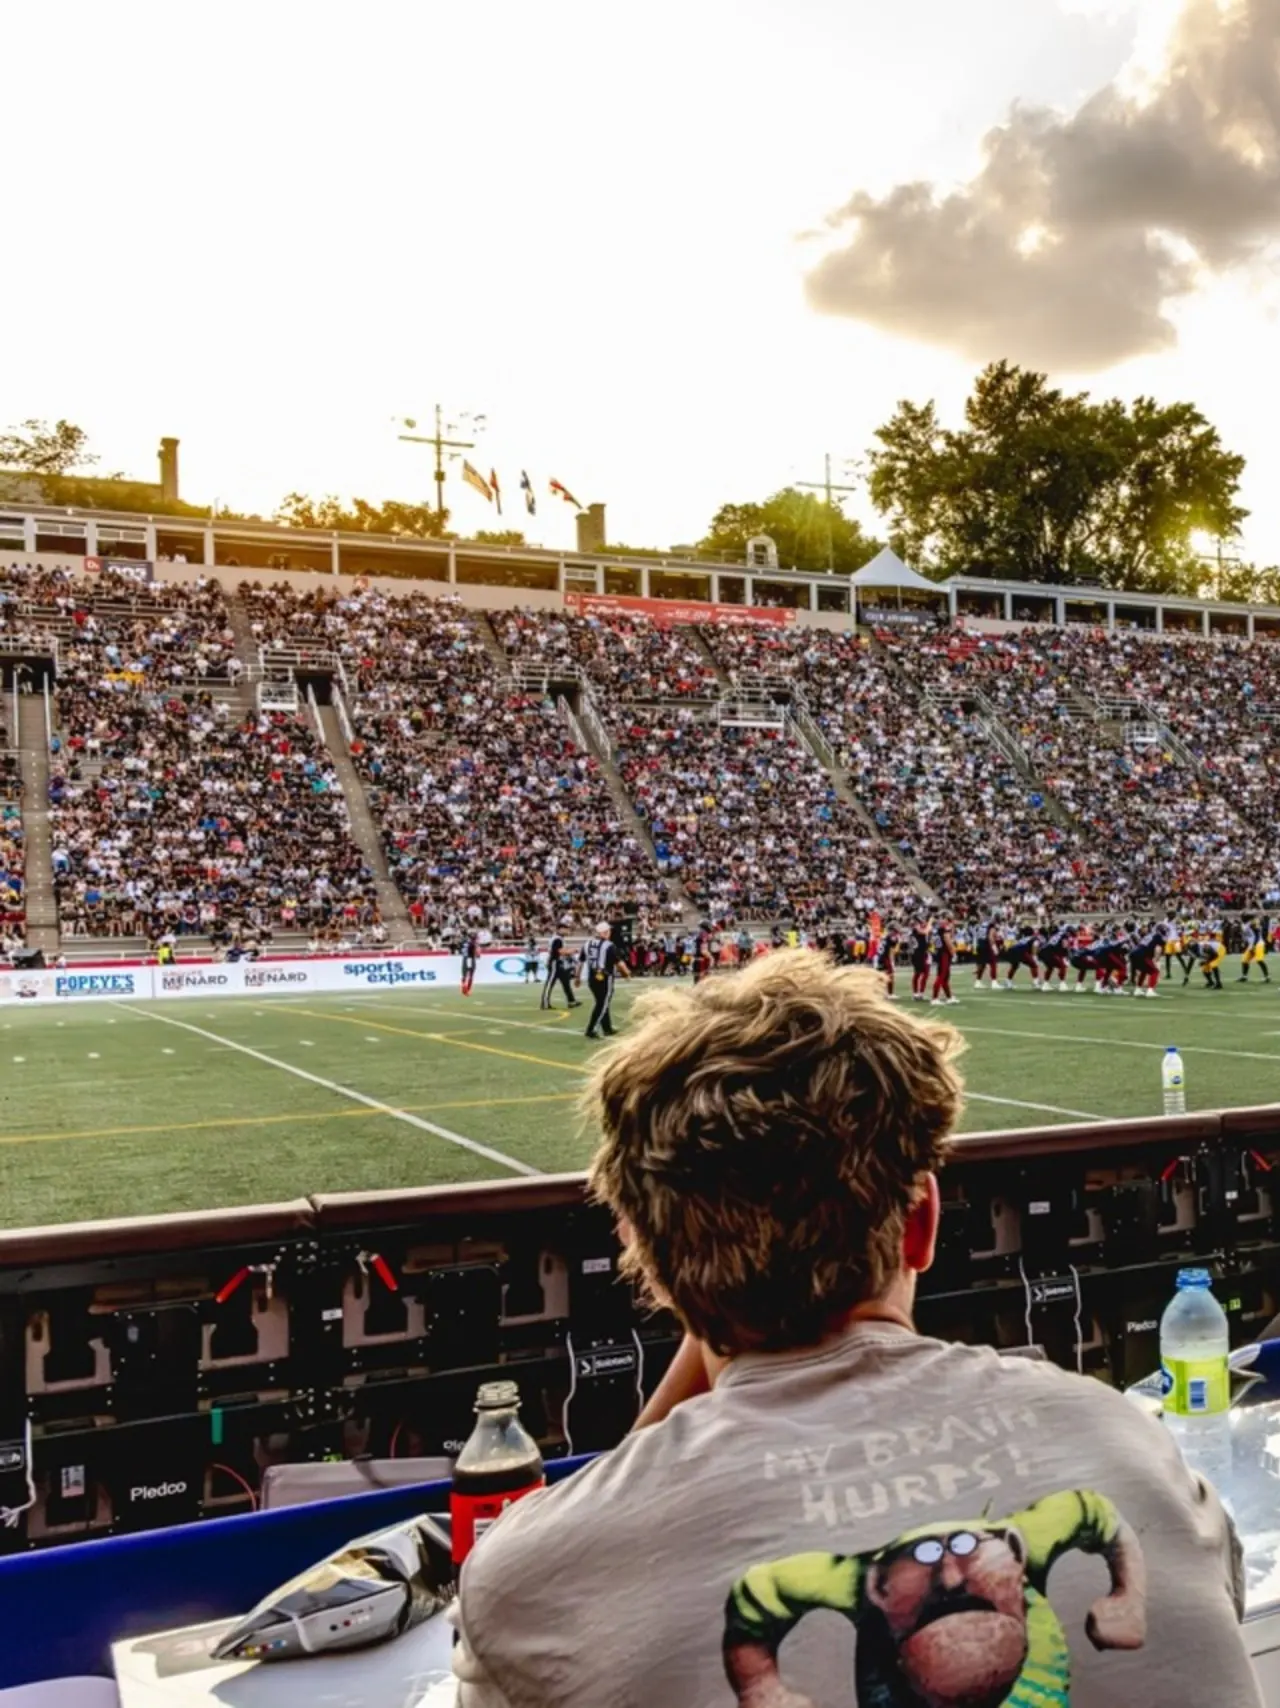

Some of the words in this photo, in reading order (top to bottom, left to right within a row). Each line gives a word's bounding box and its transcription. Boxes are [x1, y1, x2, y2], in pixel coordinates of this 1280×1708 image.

[343, 961, 404, 976] sports
[366, 968, 437, 985] experts
[55, 973, 135, 994] POPEYE'S
[764, 1443, 836, 1480] MY
[130, 1480, 188, 1502] Pledco
